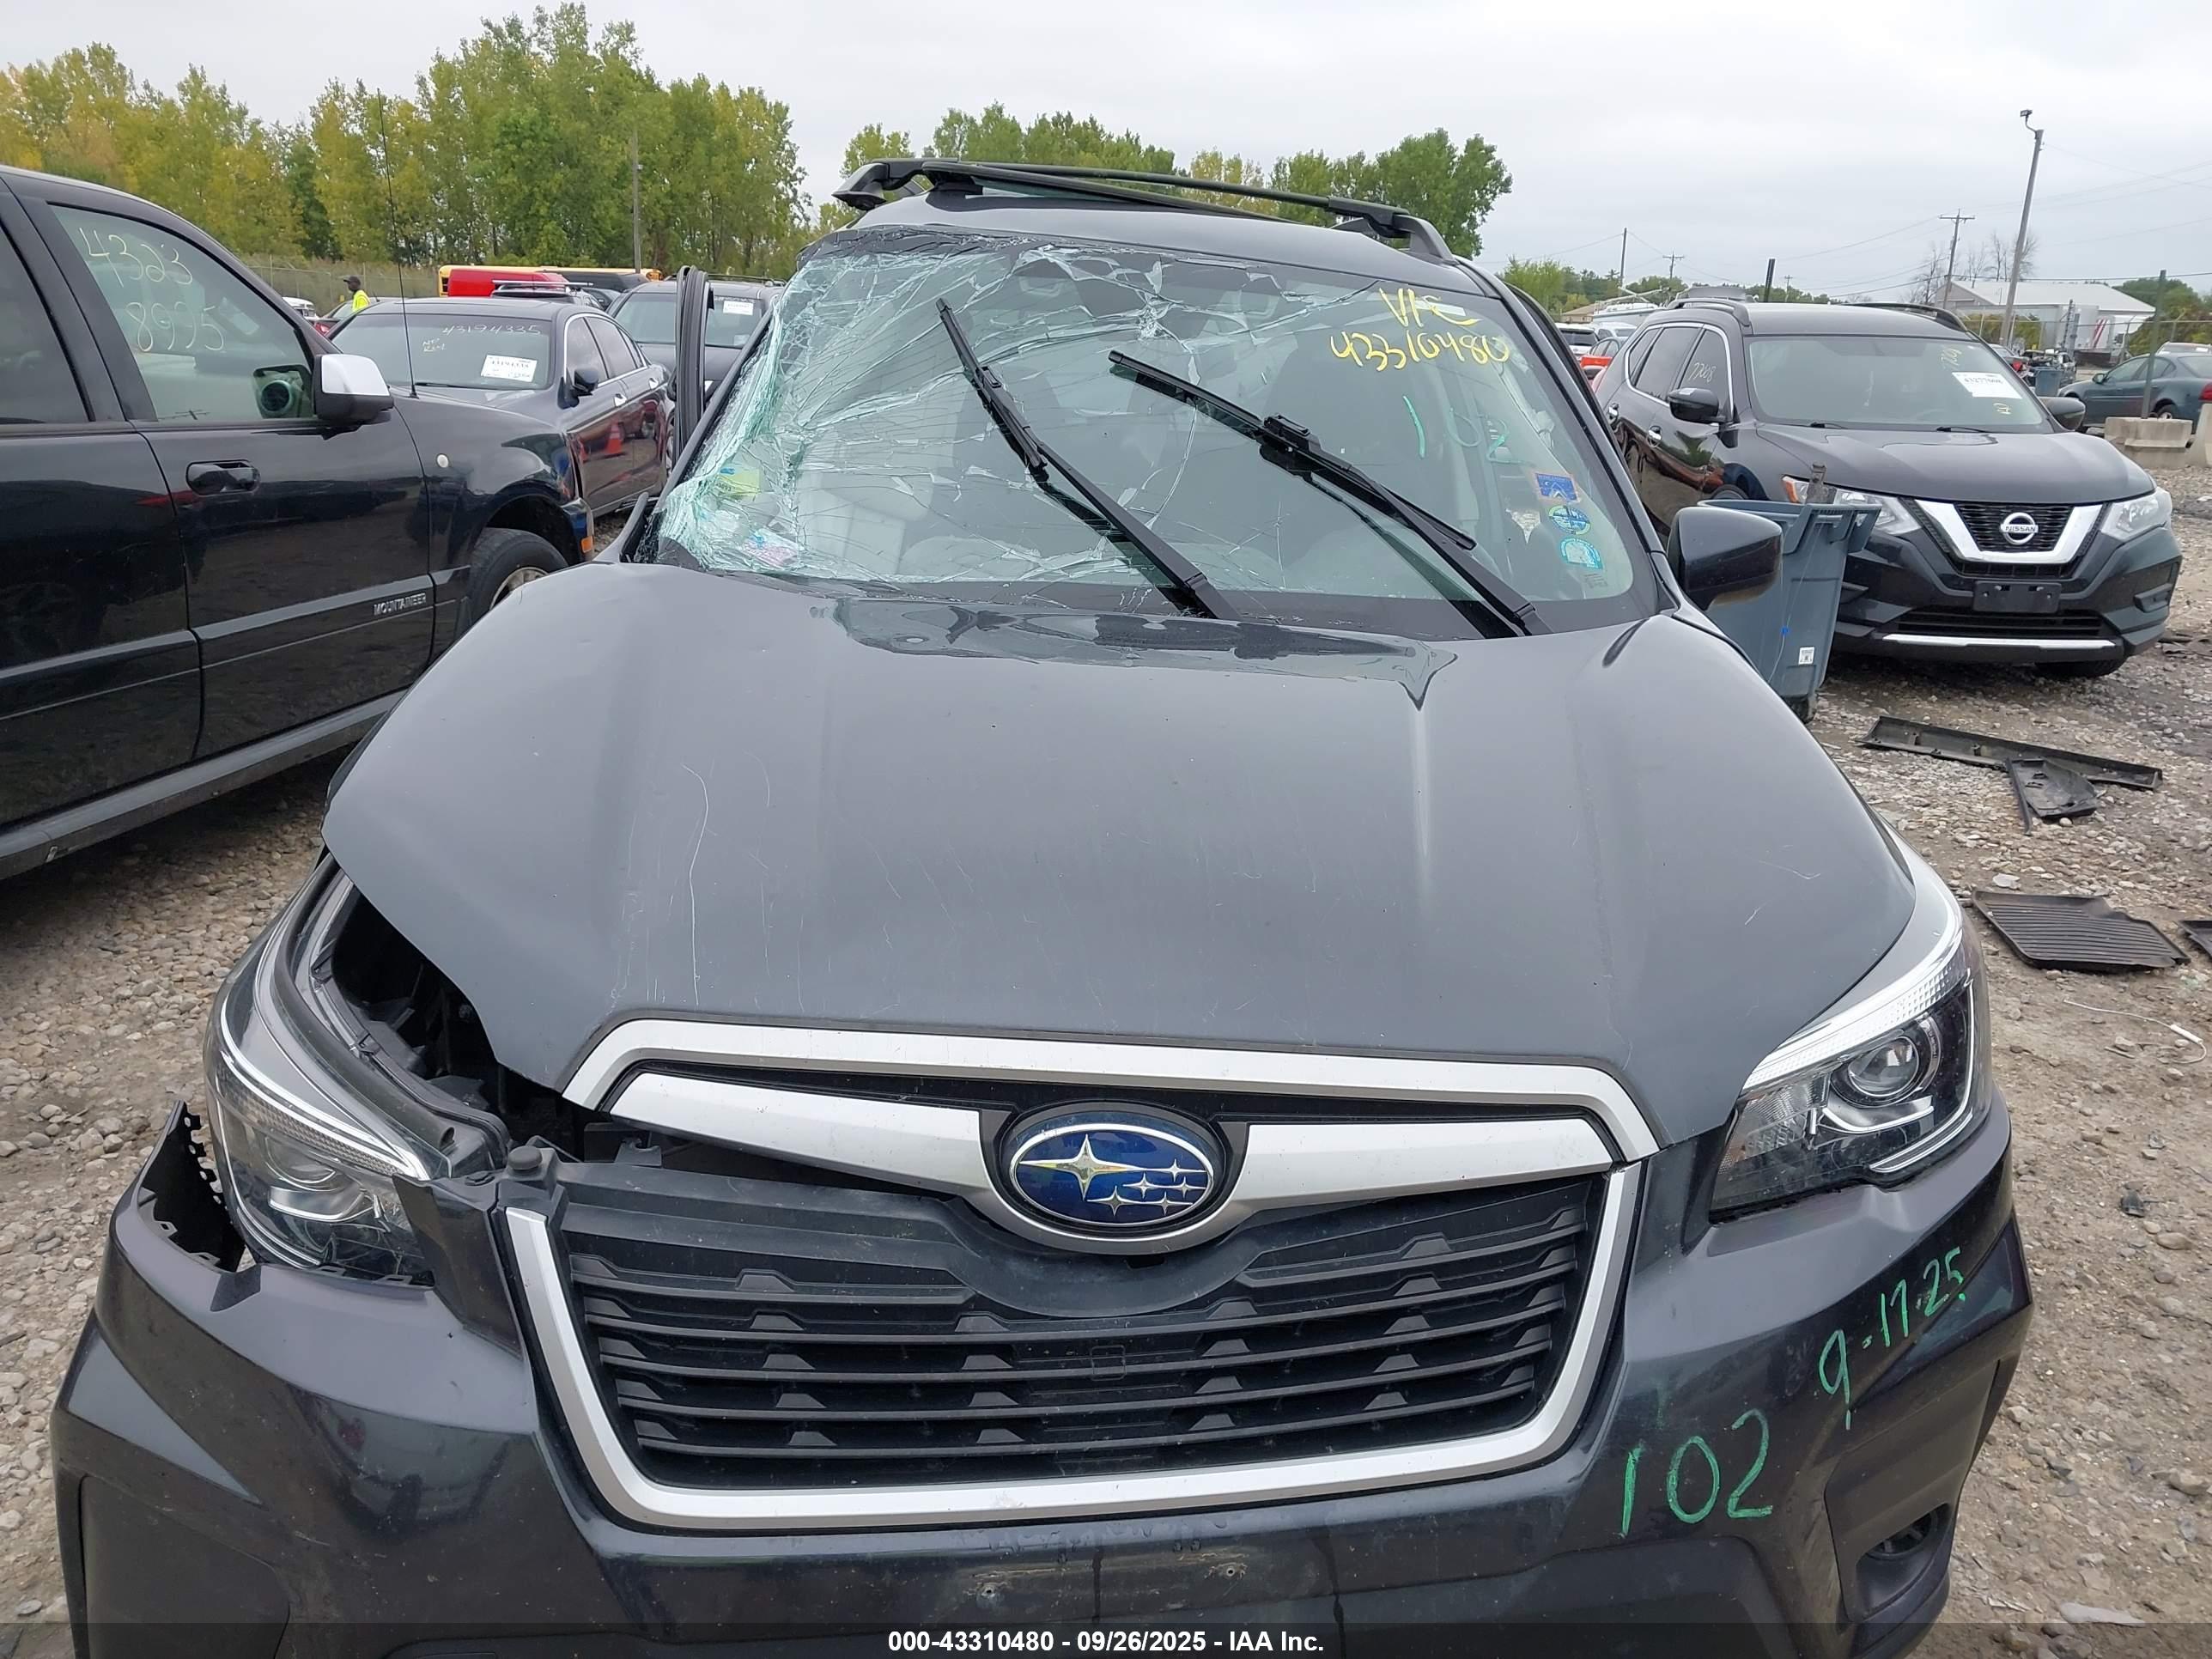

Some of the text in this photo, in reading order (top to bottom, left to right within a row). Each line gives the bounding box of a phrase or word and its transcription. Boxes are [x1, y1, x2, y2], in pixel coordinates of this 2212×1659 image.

[79, 227, 193, 288] 4323
[125, 301, 224, 352] 8995
[441, 325, 541, 336] 43194335
[1330, 329, 1510, 372] 43310480
[373, 592, 427, 616] MOUNTAINEER
[1618, 1408, 1773, 1538] 102
